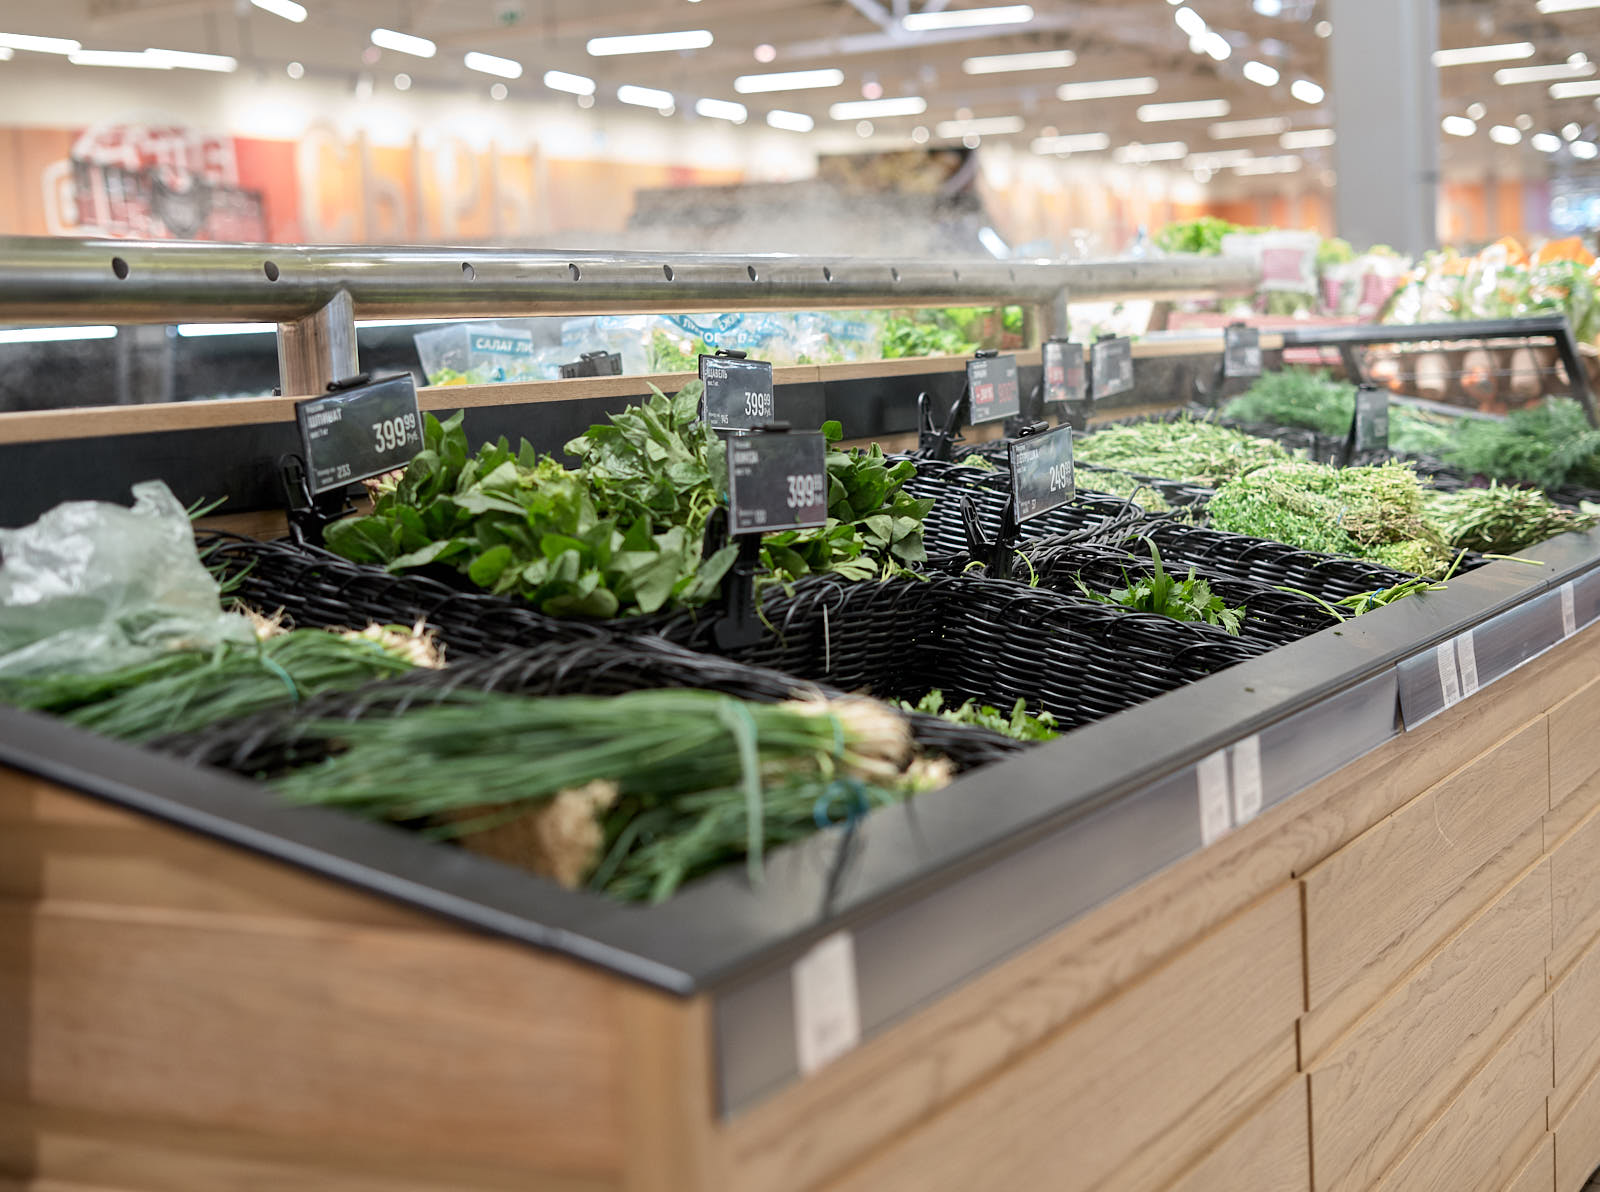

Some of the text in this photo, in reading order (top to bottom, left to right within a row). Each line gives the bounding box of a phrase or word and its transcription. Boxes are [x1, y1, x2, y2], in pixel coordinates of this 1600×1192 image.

[476, 337, 514, 352] САЛАТ
[706, 367, 728, 379] ЩАВЕЛЬ
[744, 391, 771, 416] 399 99
[307, 408, 342, 429] ШПИНАТ
[372, 413, 416, 453] 399 99
[1049, 463, 1066, 492] 249
[787, 474, 814, 508] 399
